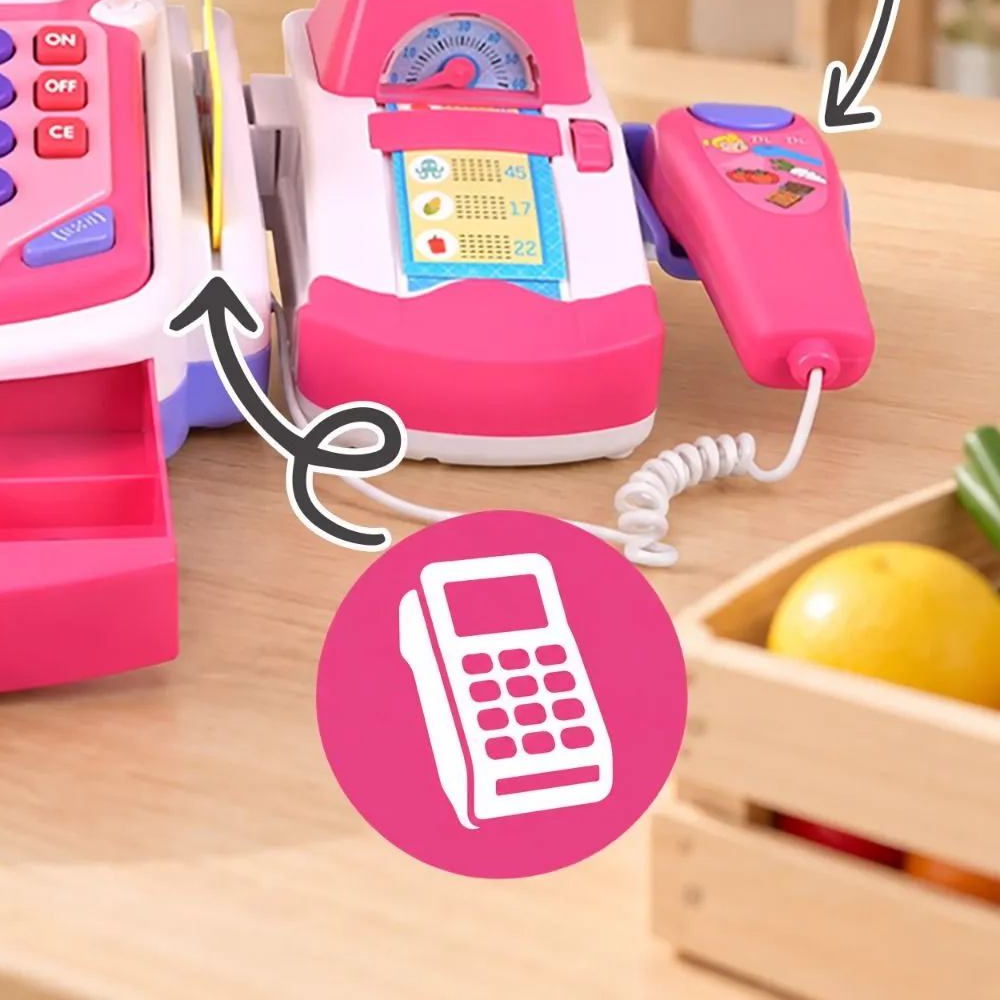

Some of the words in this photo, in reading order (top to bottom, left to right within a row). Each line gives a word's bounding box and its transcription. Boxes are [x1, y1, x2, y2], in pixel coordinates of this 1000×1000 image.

[44, 32, 76, 46] ON
[44, 78, 77, 93] OFF
[48, 125, 74, 139] CE
[503, 165, 528, 180] 45
[509, 200, 532, 217] 17
[513, 239, 538, 257] 22
